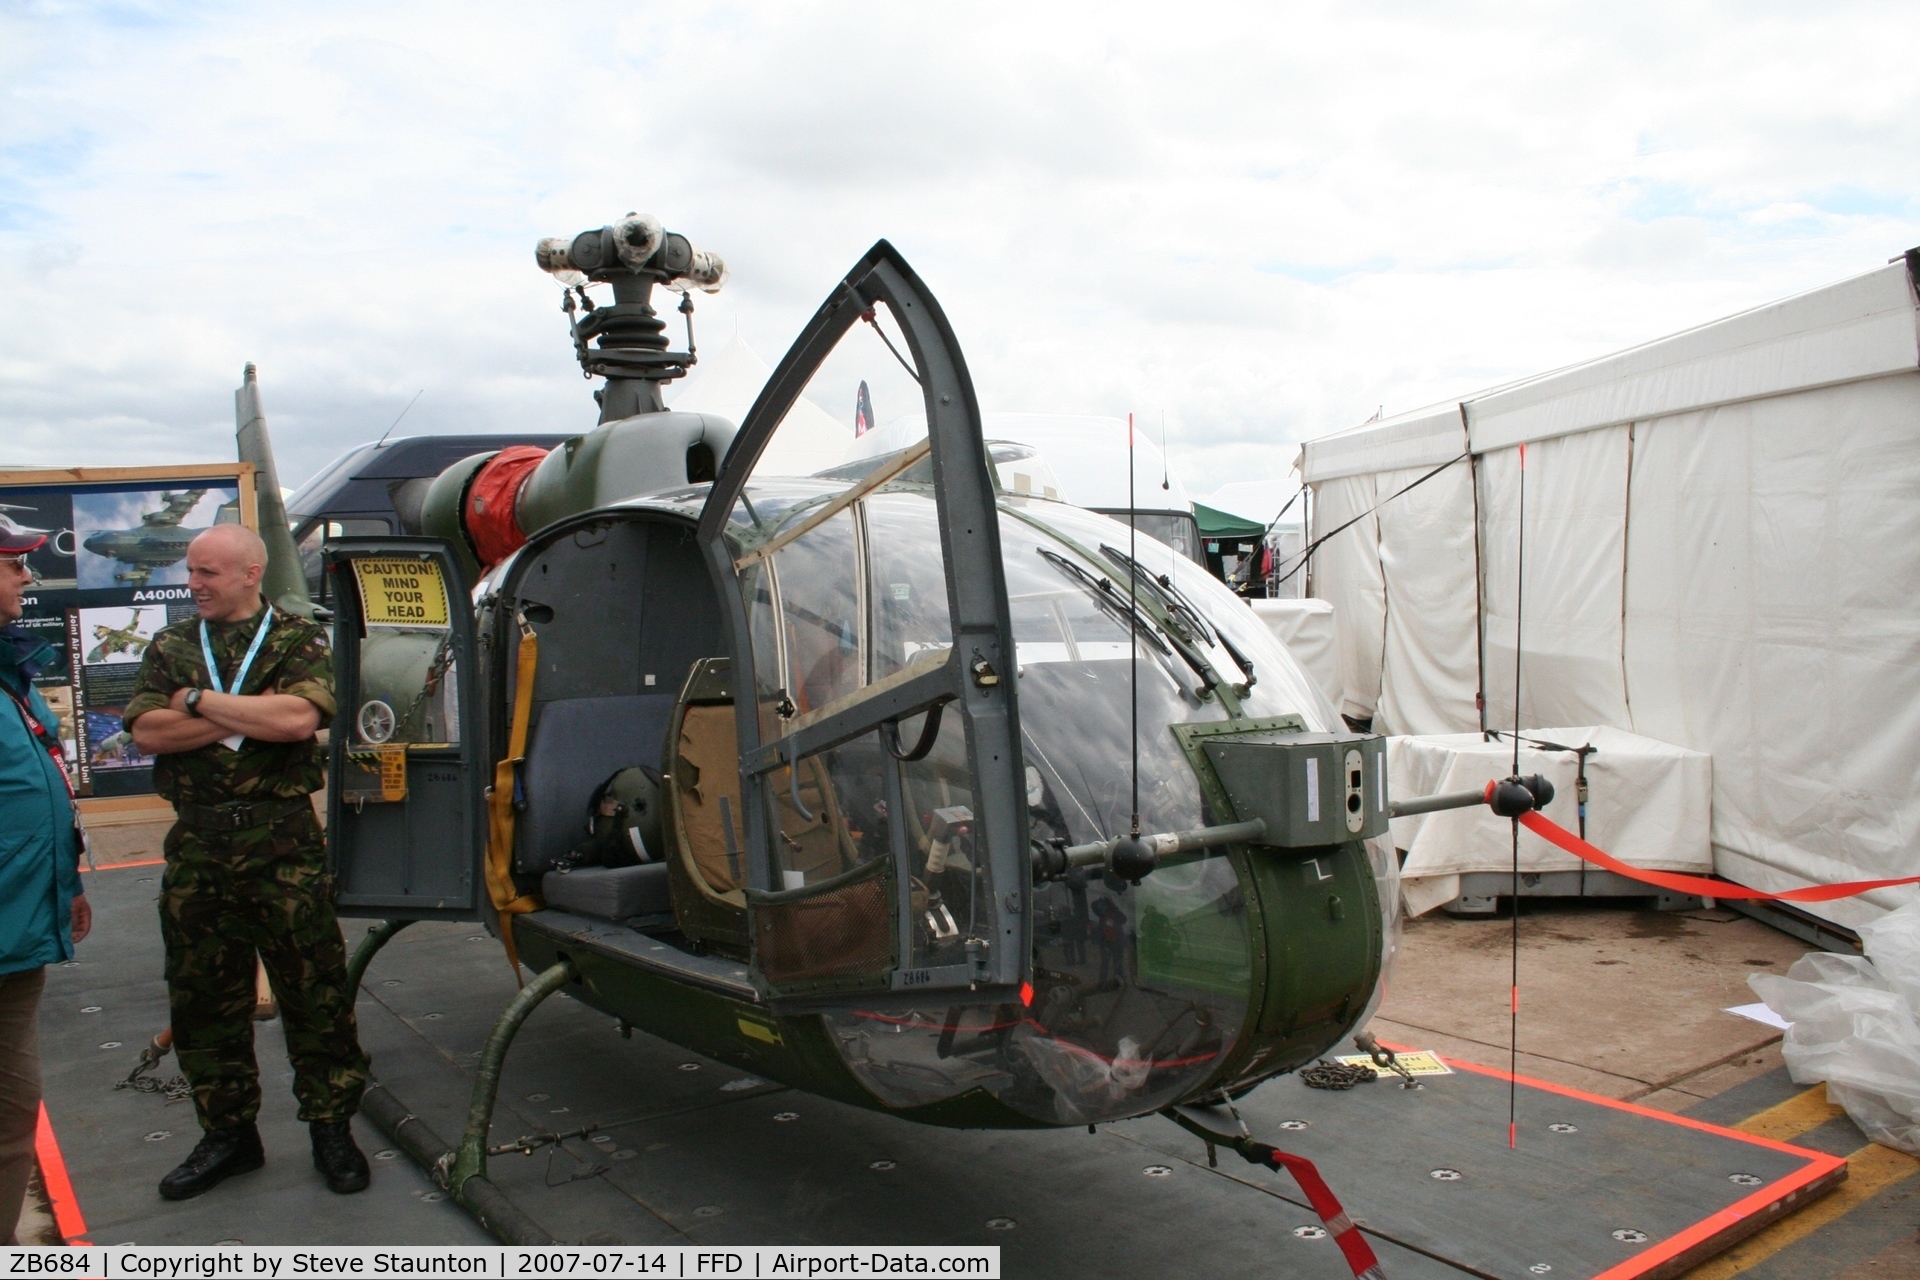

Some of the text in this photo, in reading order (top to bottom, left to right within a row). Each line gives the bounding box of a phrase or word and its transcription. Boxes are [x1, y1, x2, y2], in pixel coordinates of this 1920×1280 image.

[362, 563, 434, 575] CAUTION!
[383, 577, 419, 588] MIND
[133, 588, 191, 601] A400M
[384, 591, 424, 603] YOUR
[387, 605, 425, 617] HEAD
[70, 614, 79, 635] Joint
[72, 637, 80, 650] Air
[72, 653, 82, 689] Delivery
[75, 690, 83, 707] Test
[78, 718, 88, 764] Evaluation
[81, 765, 90, 784] Unit
